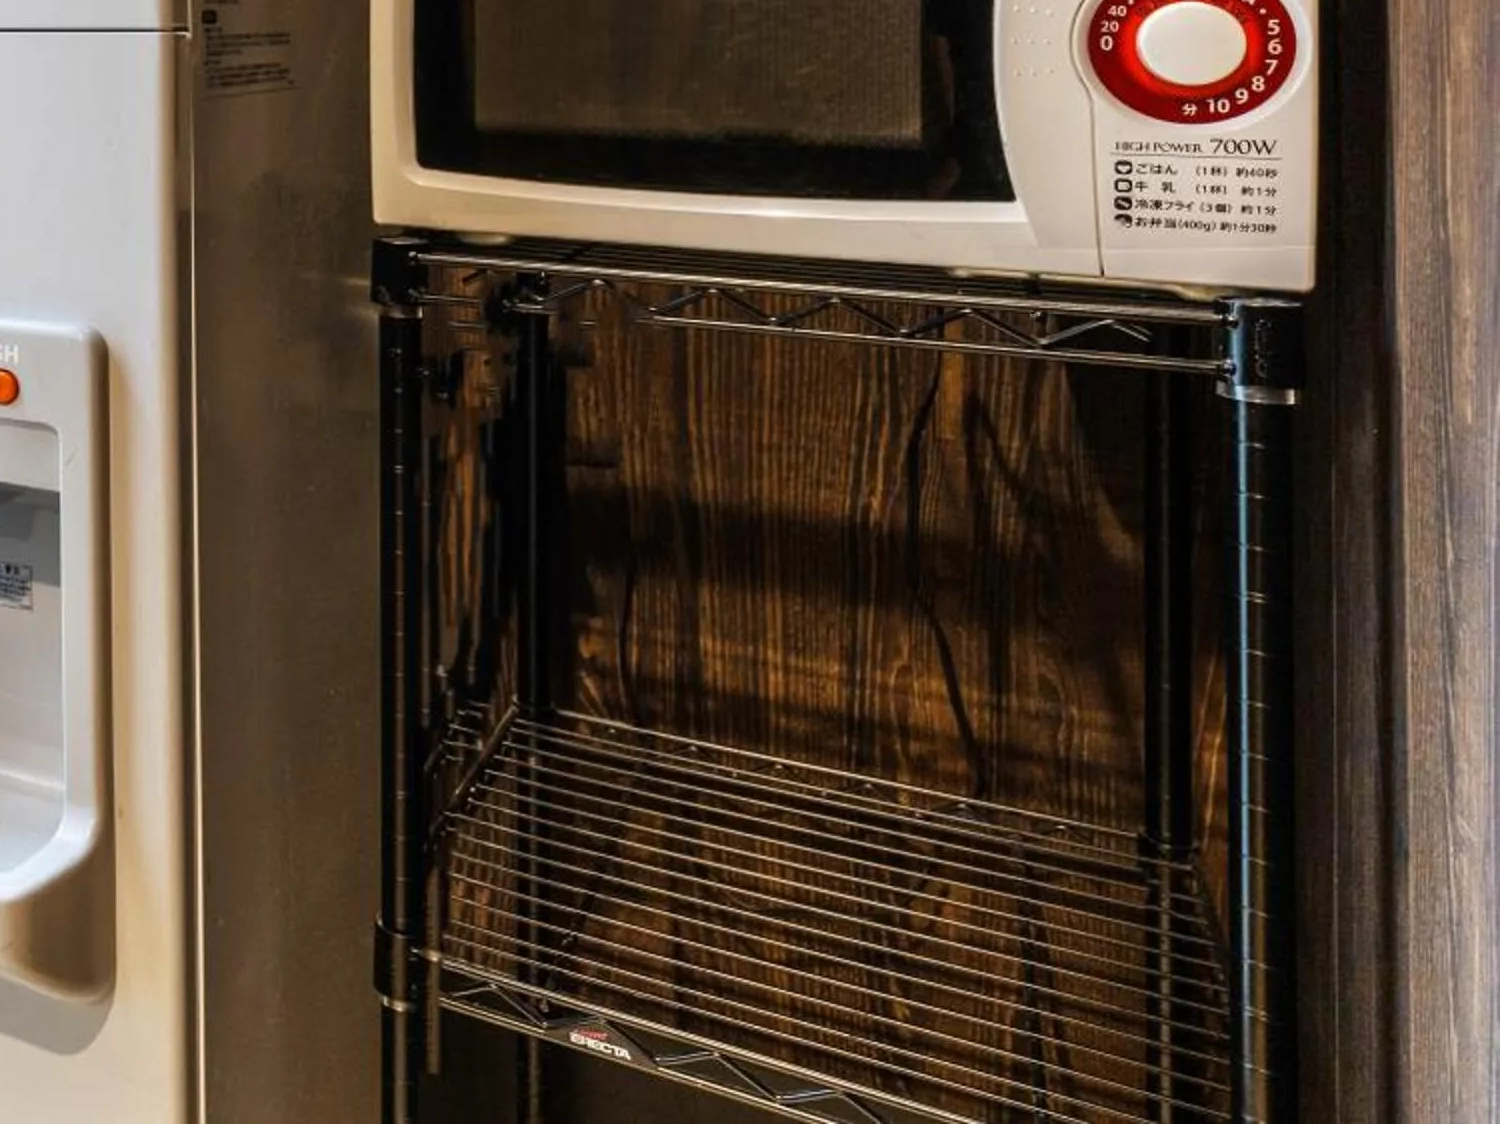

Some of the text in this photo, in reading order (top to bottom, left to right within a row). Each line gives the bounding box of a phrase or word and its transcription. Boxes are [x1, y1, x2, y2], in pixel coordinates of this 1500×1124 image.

[1108, 5, 1127, 17] 40
[1101, 21, 1119, 33] 20
[1267, 19, 1280, 35] 5
[1100, 35, 1114, 51] 0
[1267, 39, 1283, 54] 6
[1265, 59, 1279, 75] 7
[1252, 76, 1265, 92] 8
[1235, 88, 1249, 105] 9
[1206, 99, 1230, 113] 10
[1114, 138, 1278, 156] HIGH POWER 700W
[1135, 162, 1178, 175] ごはん
